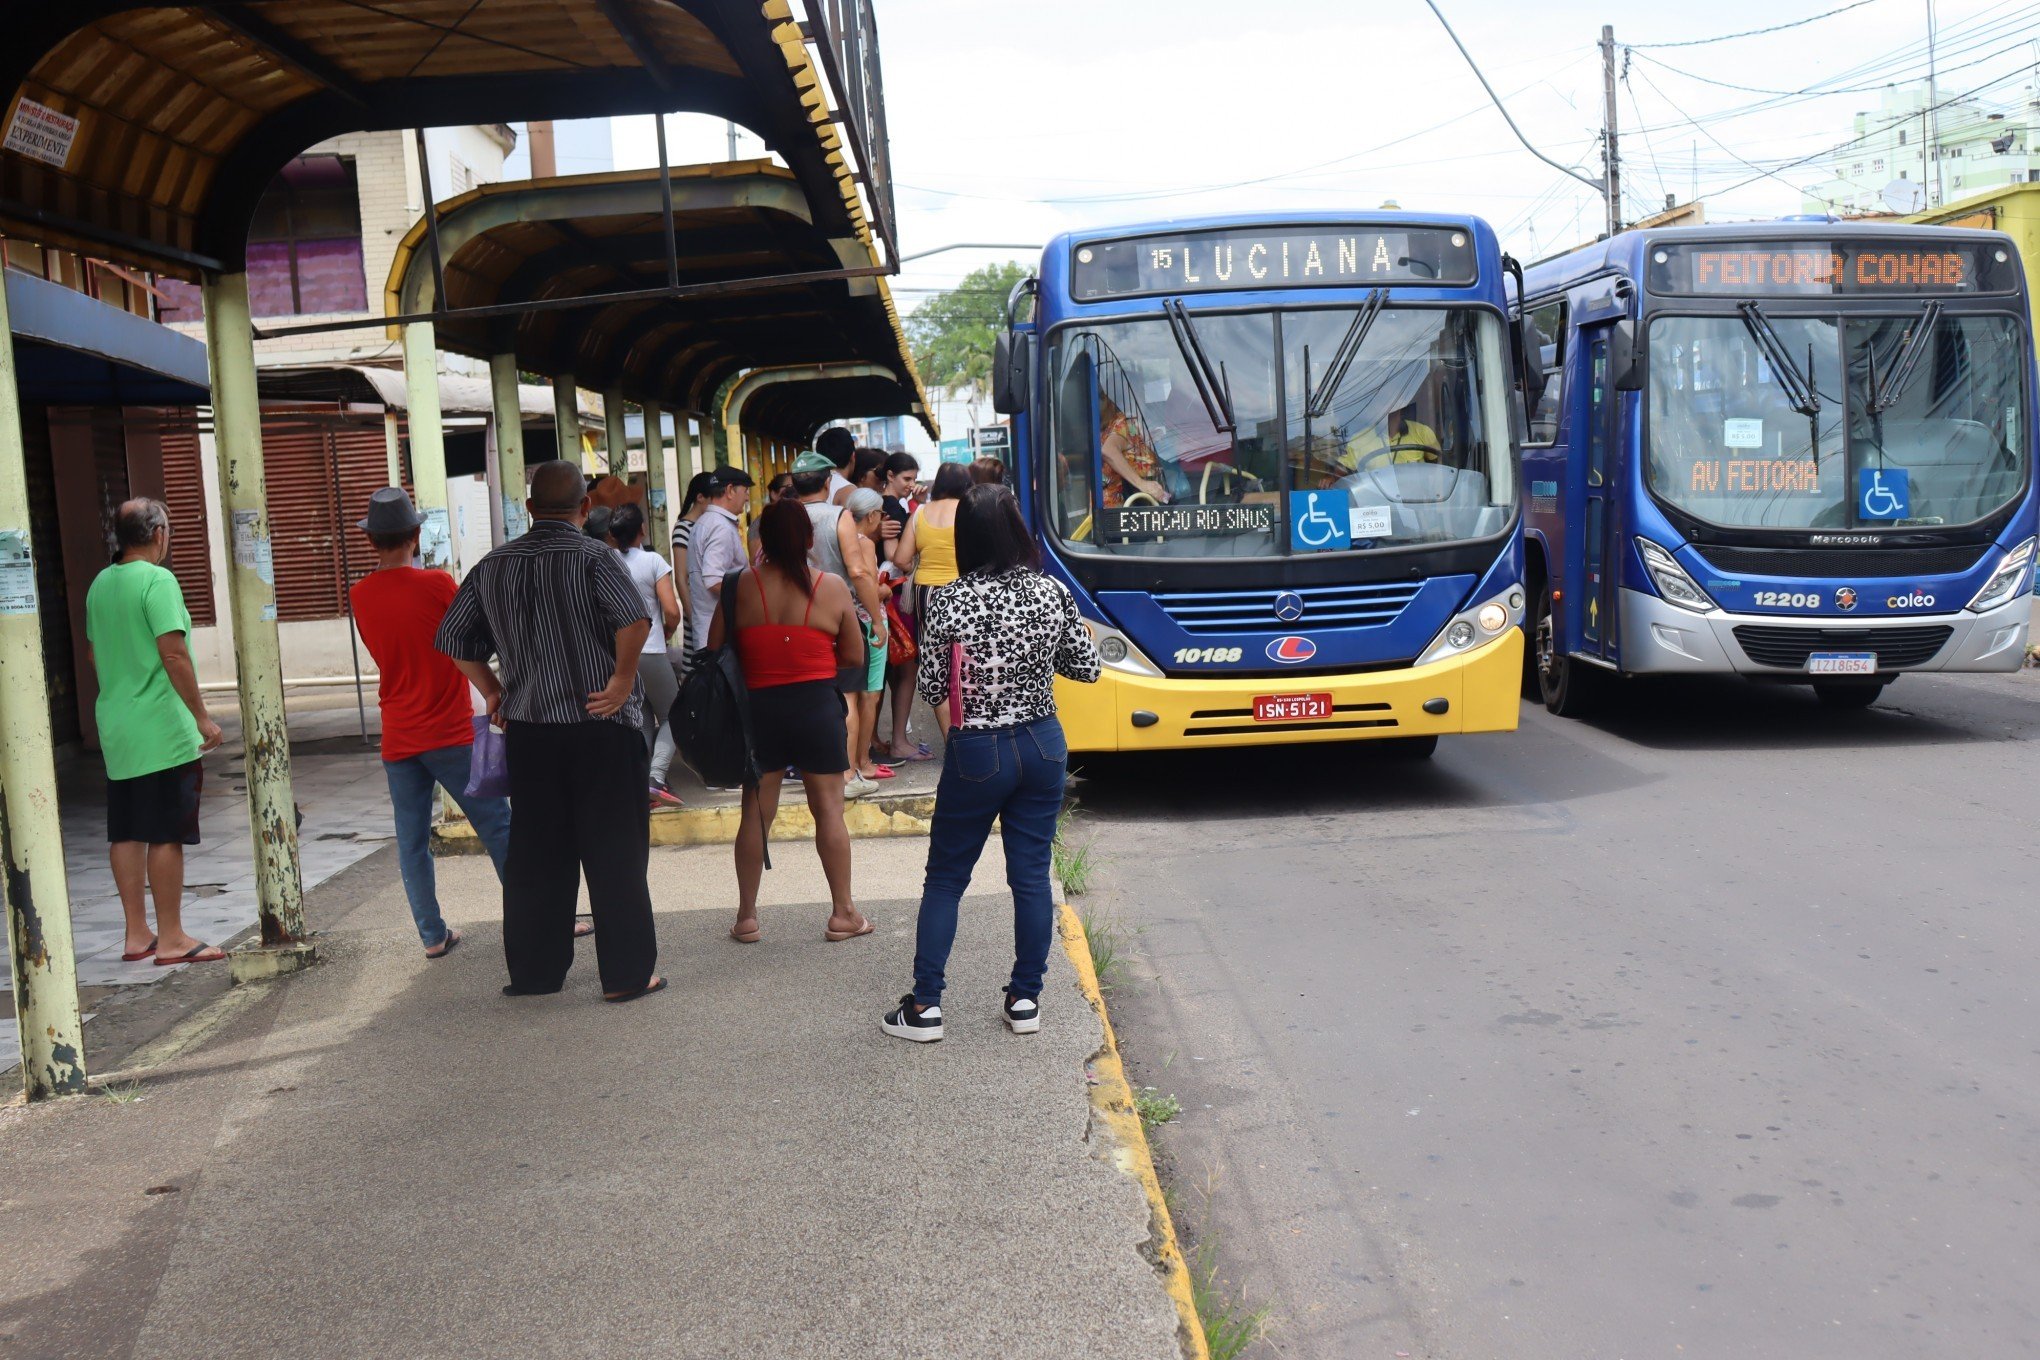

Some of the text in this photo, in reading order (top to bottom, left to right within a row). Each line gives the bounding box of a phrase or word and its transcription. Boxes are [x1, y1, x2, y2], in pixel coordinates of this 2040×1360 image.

[10, 125, 67, 157] EXPERIMENTE
[1152, 237, 1391, 282] 15 LUCIANA
[1699, 253, 1963, 284] FEITORIA COHAB
[1692, 460, 1818, 490] AV FEITORIA
[1196, 510, 1220, 530] RIO
[1812, 535, 1880, 544] Marcopolo
[1753, 591, 1820, 608] 12208
[1173, 647, 1243, 663] 10188
